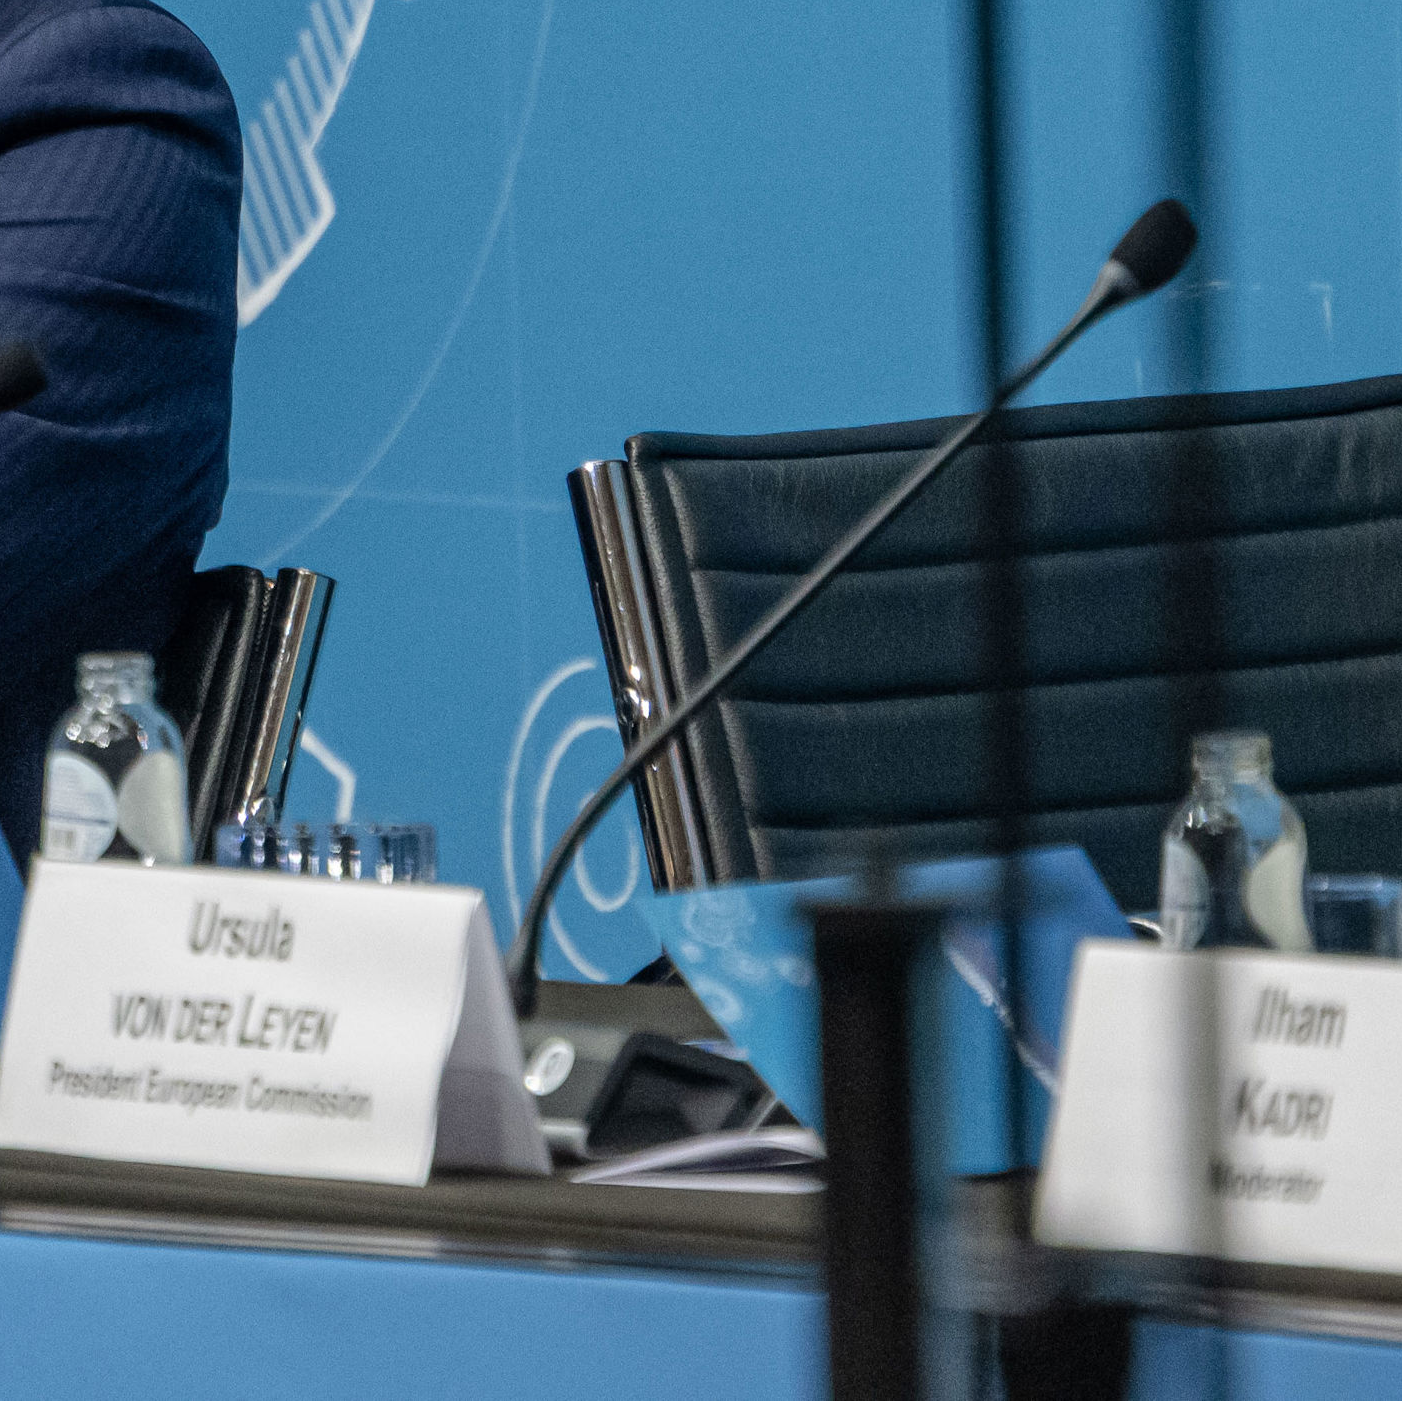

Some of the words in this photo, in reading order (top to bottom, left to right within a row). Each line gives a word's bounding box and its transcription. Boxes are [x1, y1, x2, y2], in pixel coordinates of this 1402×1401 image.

[189, 901, 294, 962] Ursula
[111, 994, 169, 1040] VON
[172, 997, 233, 1046] DER
[237, 992, 337, 1055] LEYEN
[1252, 984, 1346, 1049] Ilham
[48, 1059, 143, 1103] President
[146, 1067, 240, 1115] European
[244, 1071, 373, 1123] Commission
[1231, 1079, 1335, 1142] KADRI
